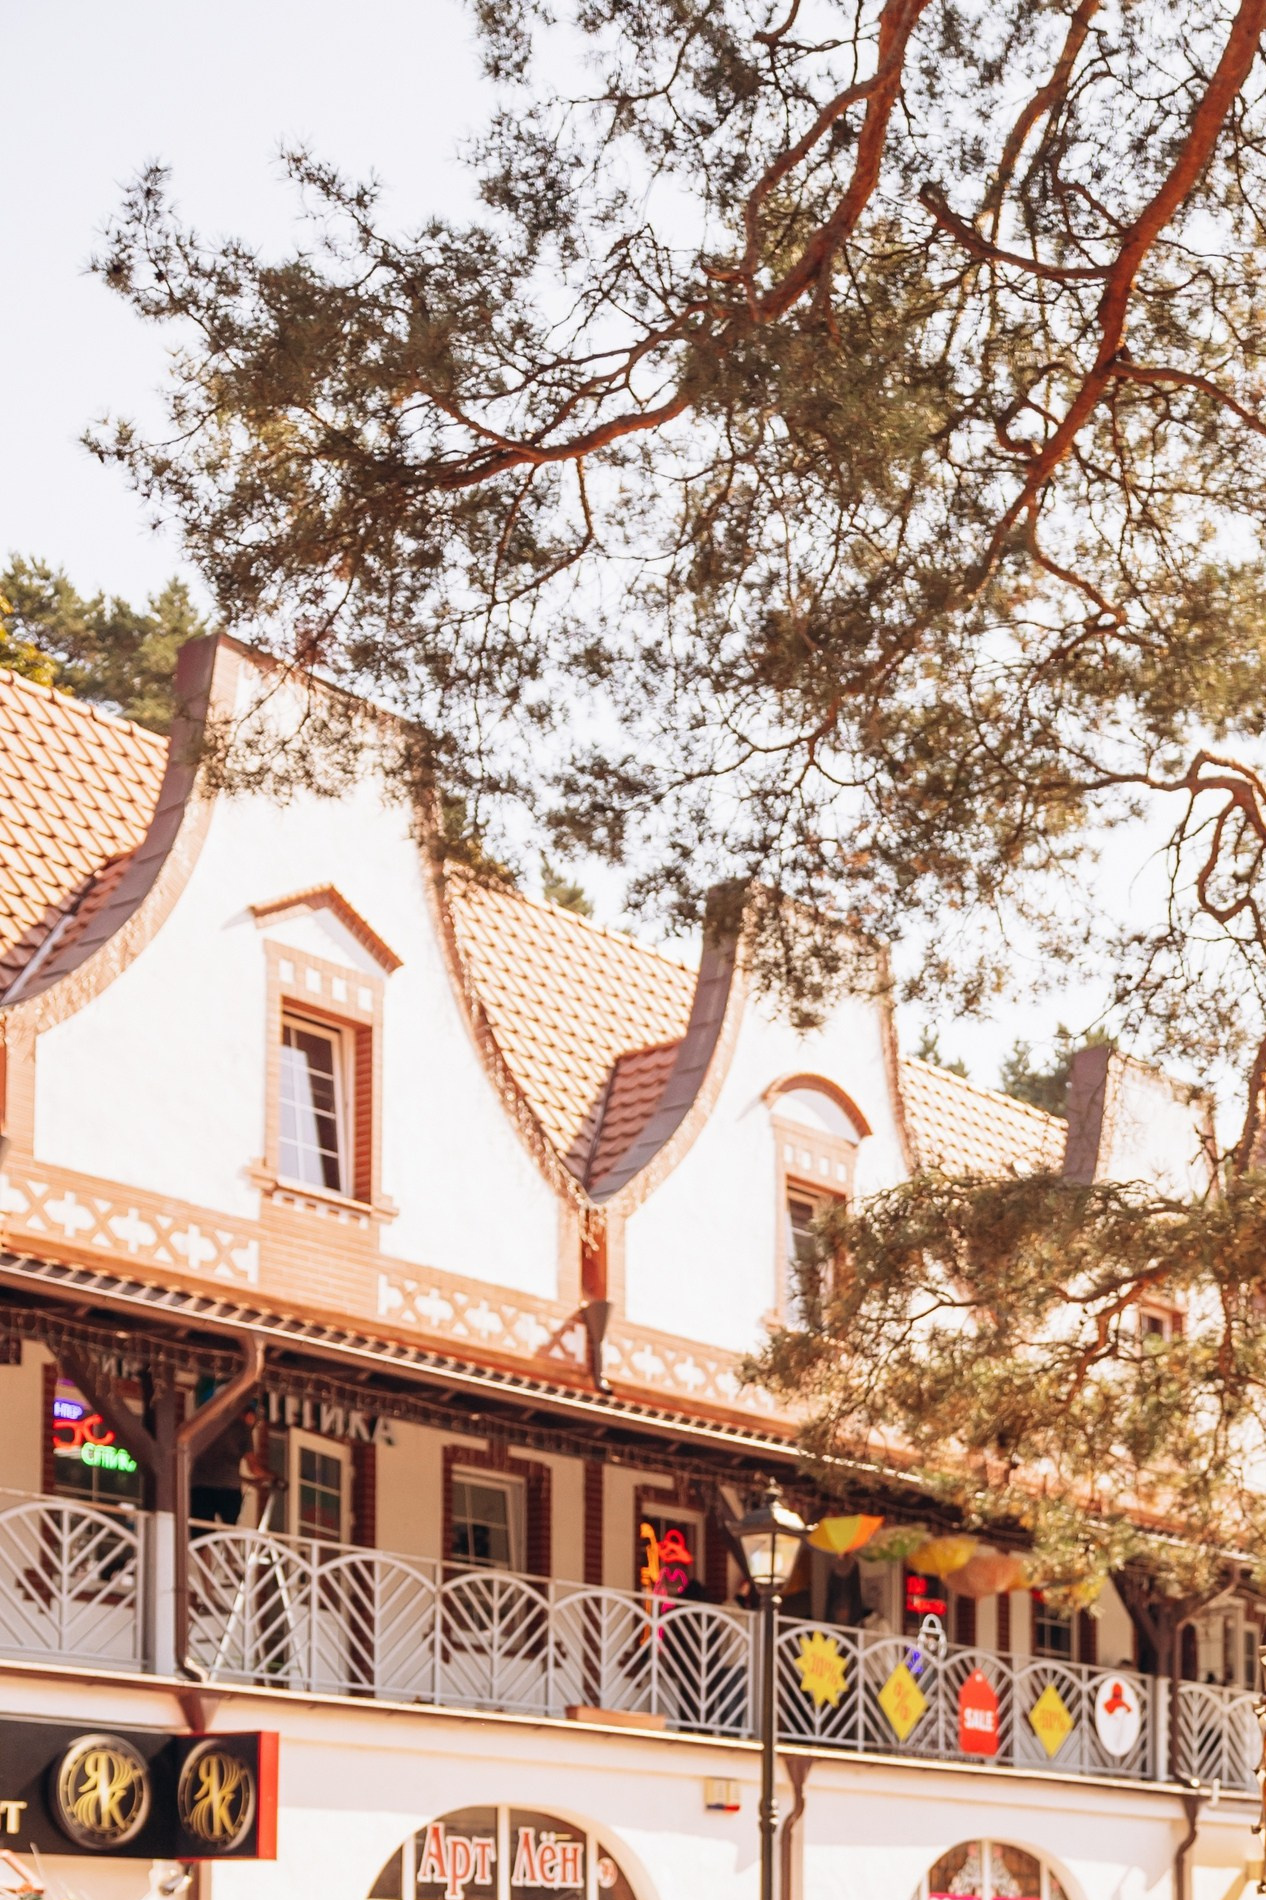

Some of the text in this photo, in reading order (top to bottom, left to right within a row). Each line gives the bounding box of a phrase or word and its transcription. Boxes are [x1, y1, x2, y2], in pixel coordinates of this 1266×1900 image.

[963, 1708, 995, 1733] SALE
[417, 1822, 585, 1900] Арт Лён
